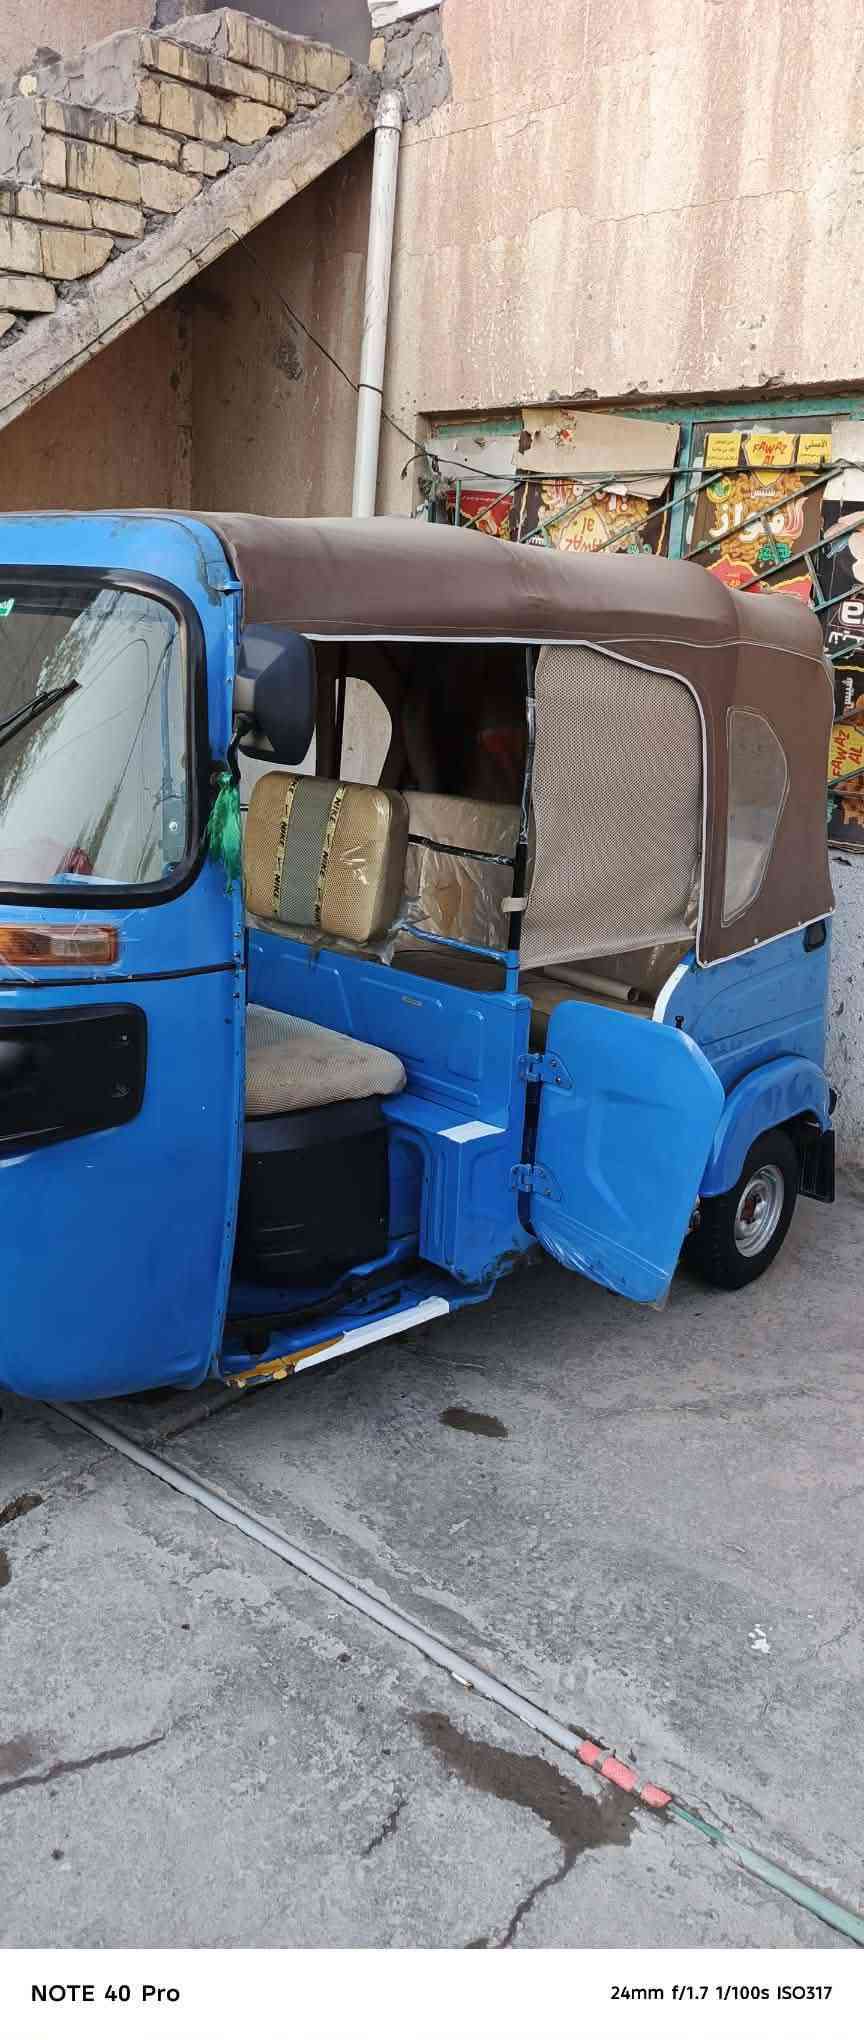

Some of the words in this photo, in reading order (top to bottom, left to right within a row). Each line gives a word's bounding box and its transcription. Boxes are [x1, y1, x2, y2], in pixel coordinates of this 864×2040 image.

[752, 440, 788, 455] FAWAZ
[831, 730, 850, 777] FAWAZ
[328, 798, 341, 821] NIKE
[319, 850, 329, 877] NIKE
[273, 873, 281, 897] NIKE
